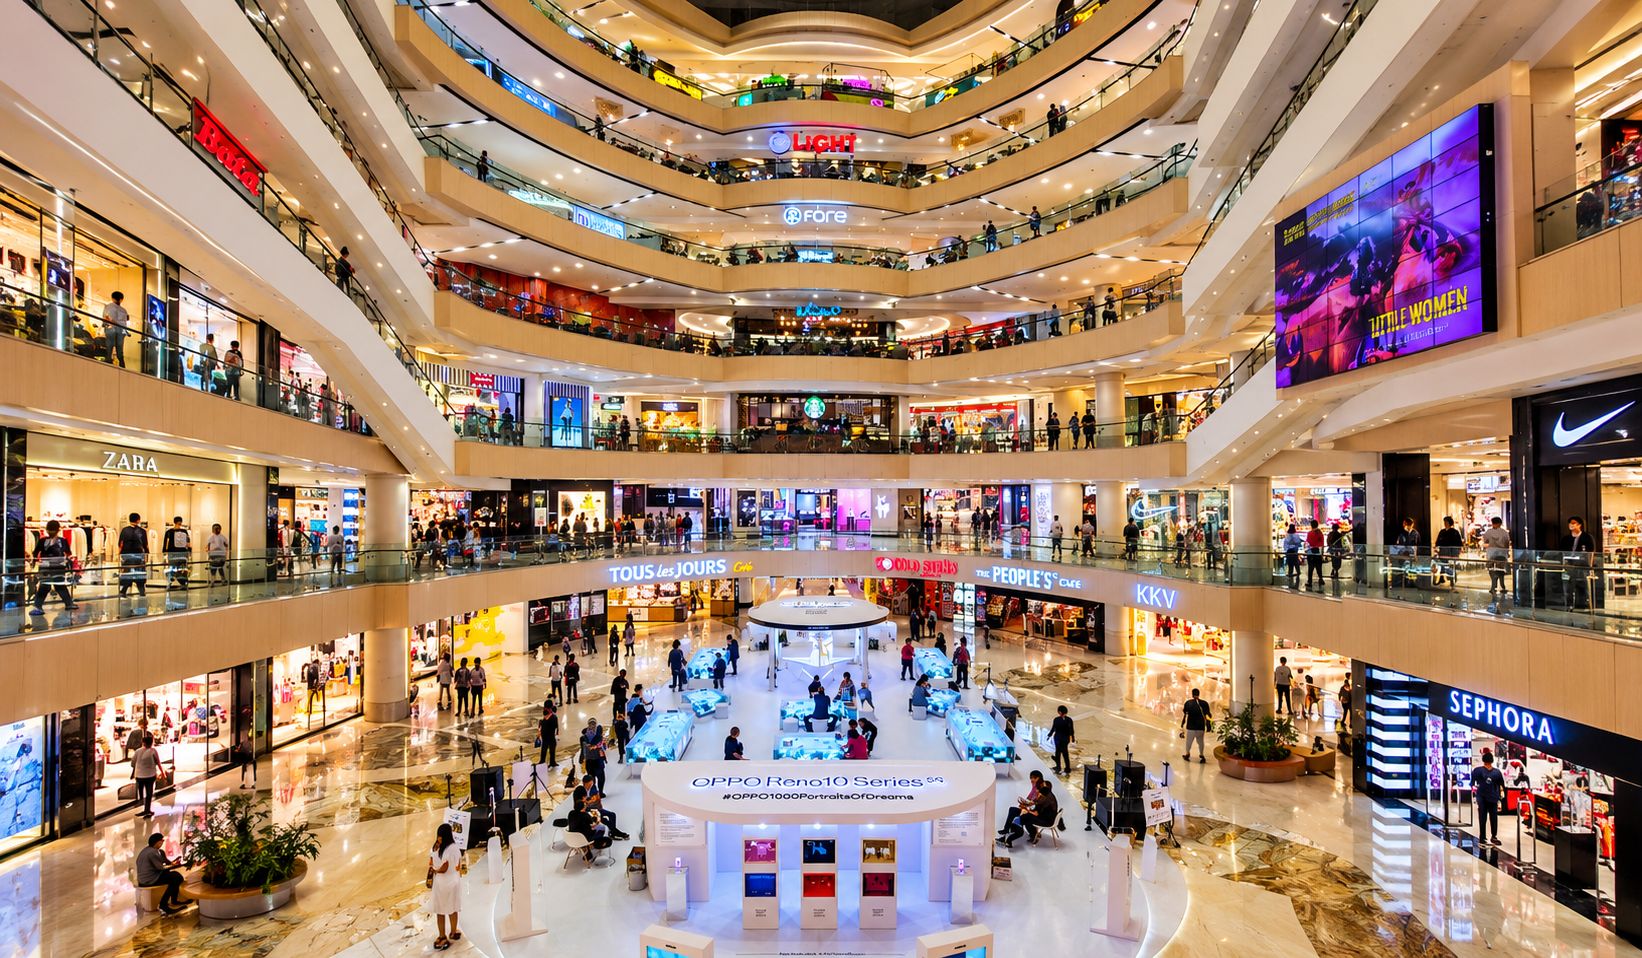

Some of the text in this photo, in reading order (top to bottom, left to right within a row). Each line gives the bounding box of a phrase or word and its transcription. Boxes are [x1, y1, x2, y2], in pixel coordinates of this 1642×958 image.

[193, 116, 260, 197] Bata
[1409, 285, 1468, 326] WOMEN
[102, 451, 159, 473] ZARA
[608, 563, 655, 583] TOUS
[656, 563, 675, 578] les
[674, 558, 727, 579] JOURS
[992, 565, 1053, 591] PEOPLE'S
[1136, 583, 1177, 610] KKV
[1450, 690, 1555, 745] SEPHORA
[692, 776, 762, 788] OPPO
[766, 775, 849, 788] Reno10
[853, 775, 924, 788] Series
[722, 792, 915, 801] #OPPO1000PortraitsOfDreams
